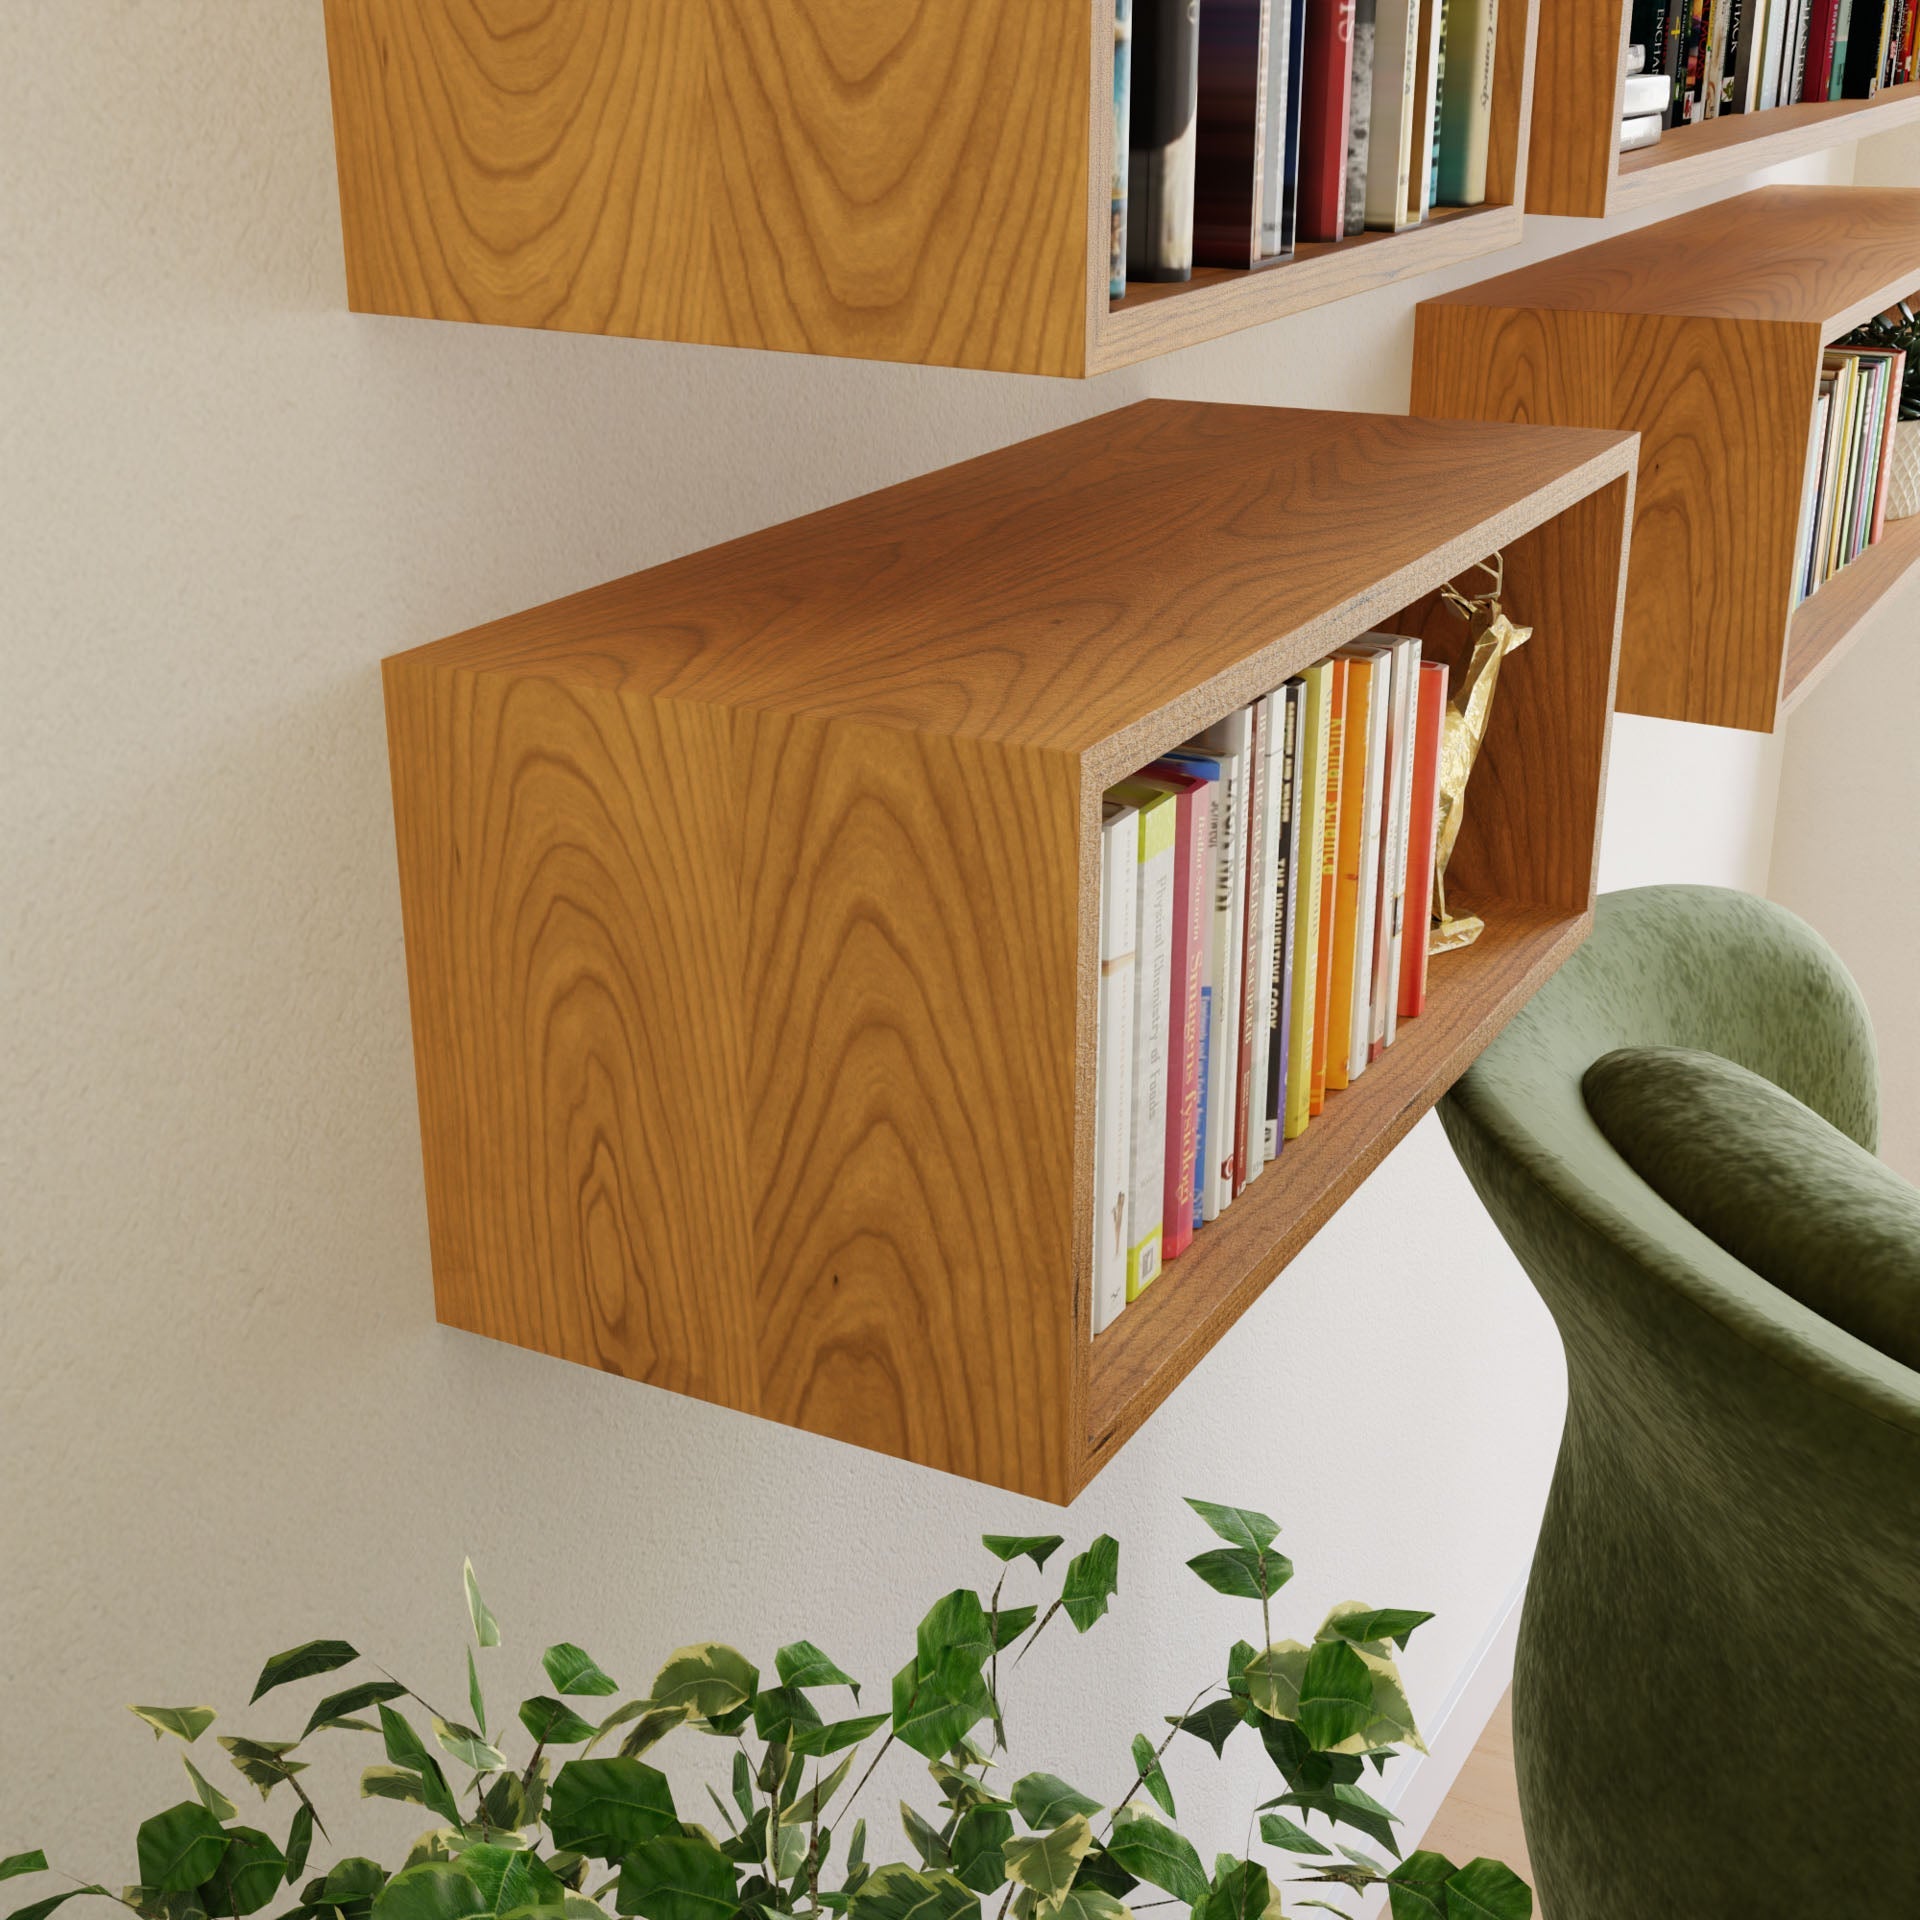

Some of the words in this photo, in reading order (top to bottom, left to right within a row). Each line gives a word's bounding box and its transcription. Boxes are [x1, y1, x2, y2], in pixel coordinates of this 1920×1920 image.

[1730, 0, 1742, 52] HACK
[1479, 25, 1494, 110] Comedy
[1257, 713, 1266, 756] BUT
[1320, 688, 1332, 795] Molecular
[1255, 765, 1264, 809] THE
[1249, 812, 1262, 938] CRACKLING
[1276, 857, 1286, 887] THE
[1311, 804, 1326, 937] Gastronomy
[1152, 872, 1167, 950] Physical
[1272, 891, 1284, 982] INQUISITIVE
[1248, 943, 1256, 962] IS
[1149, 952, 1164, 1044] Chemistry
[1182, 948, 1203, 1087] Smagens
[1244, 965, 1255, 1044] SUPERB
[1269, 986, 1279, 1028] COOK
[1149, 1043, 1160, 1065] of
[1148, 1068, 1159, 1122] Foods
[1178, 1086, 1197, 1208] fysiologi
